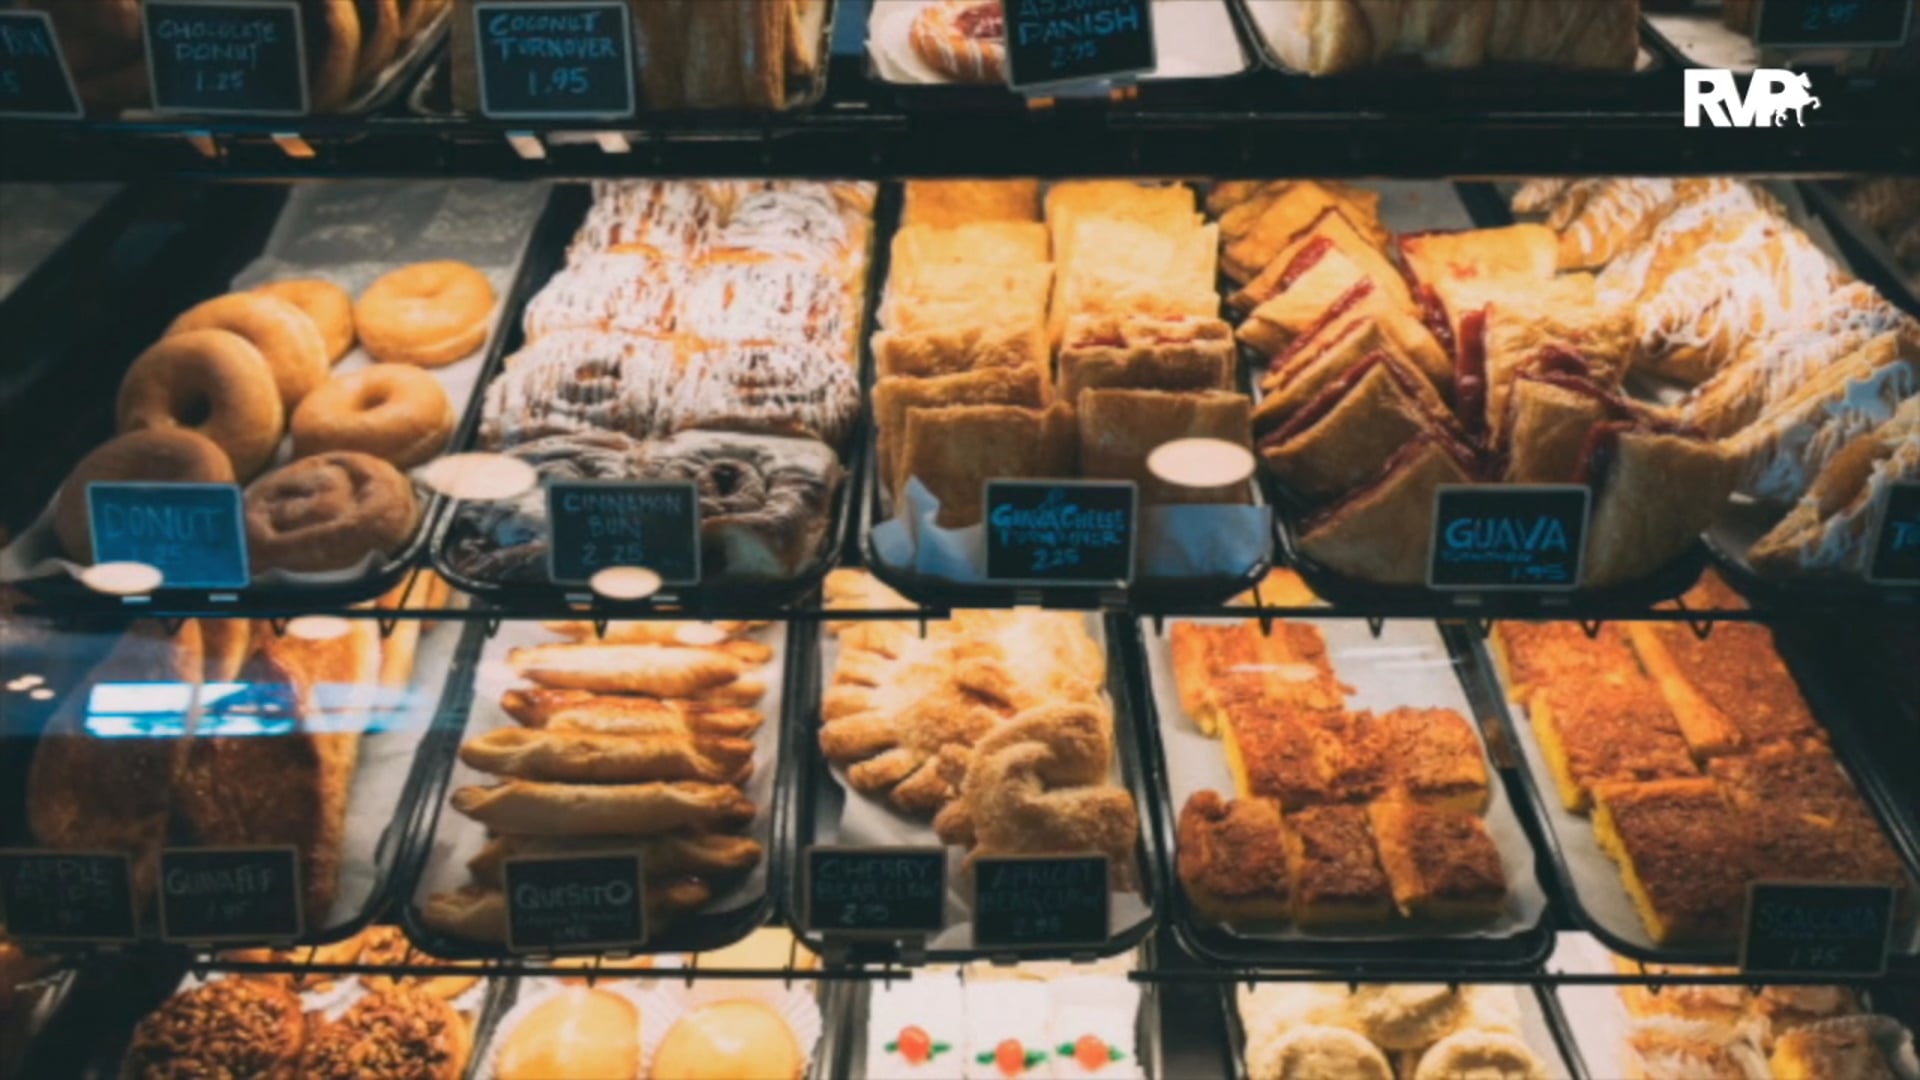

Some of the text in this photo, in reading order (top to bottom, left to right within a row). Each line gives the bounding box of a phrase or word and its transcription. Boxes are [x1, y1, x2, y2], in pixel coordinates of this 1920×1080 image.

[156, 19, 278, 43] CHOCOLATE
[488, 11, 603, 37] COCONUT
[1018, 5, 1139, 47] DANISH
[175, 42, 259, 67] DONUT
[492, 37, 617, 62] TURNOVER
[527, 66, 591, 97] 1.95
[103, 502, 226, 542] DONUT
[588, 514, 642, 538] BUN
[1444, 515, 1570, 552] GUAVA
[515, 879, 634, 910] QUESITO
